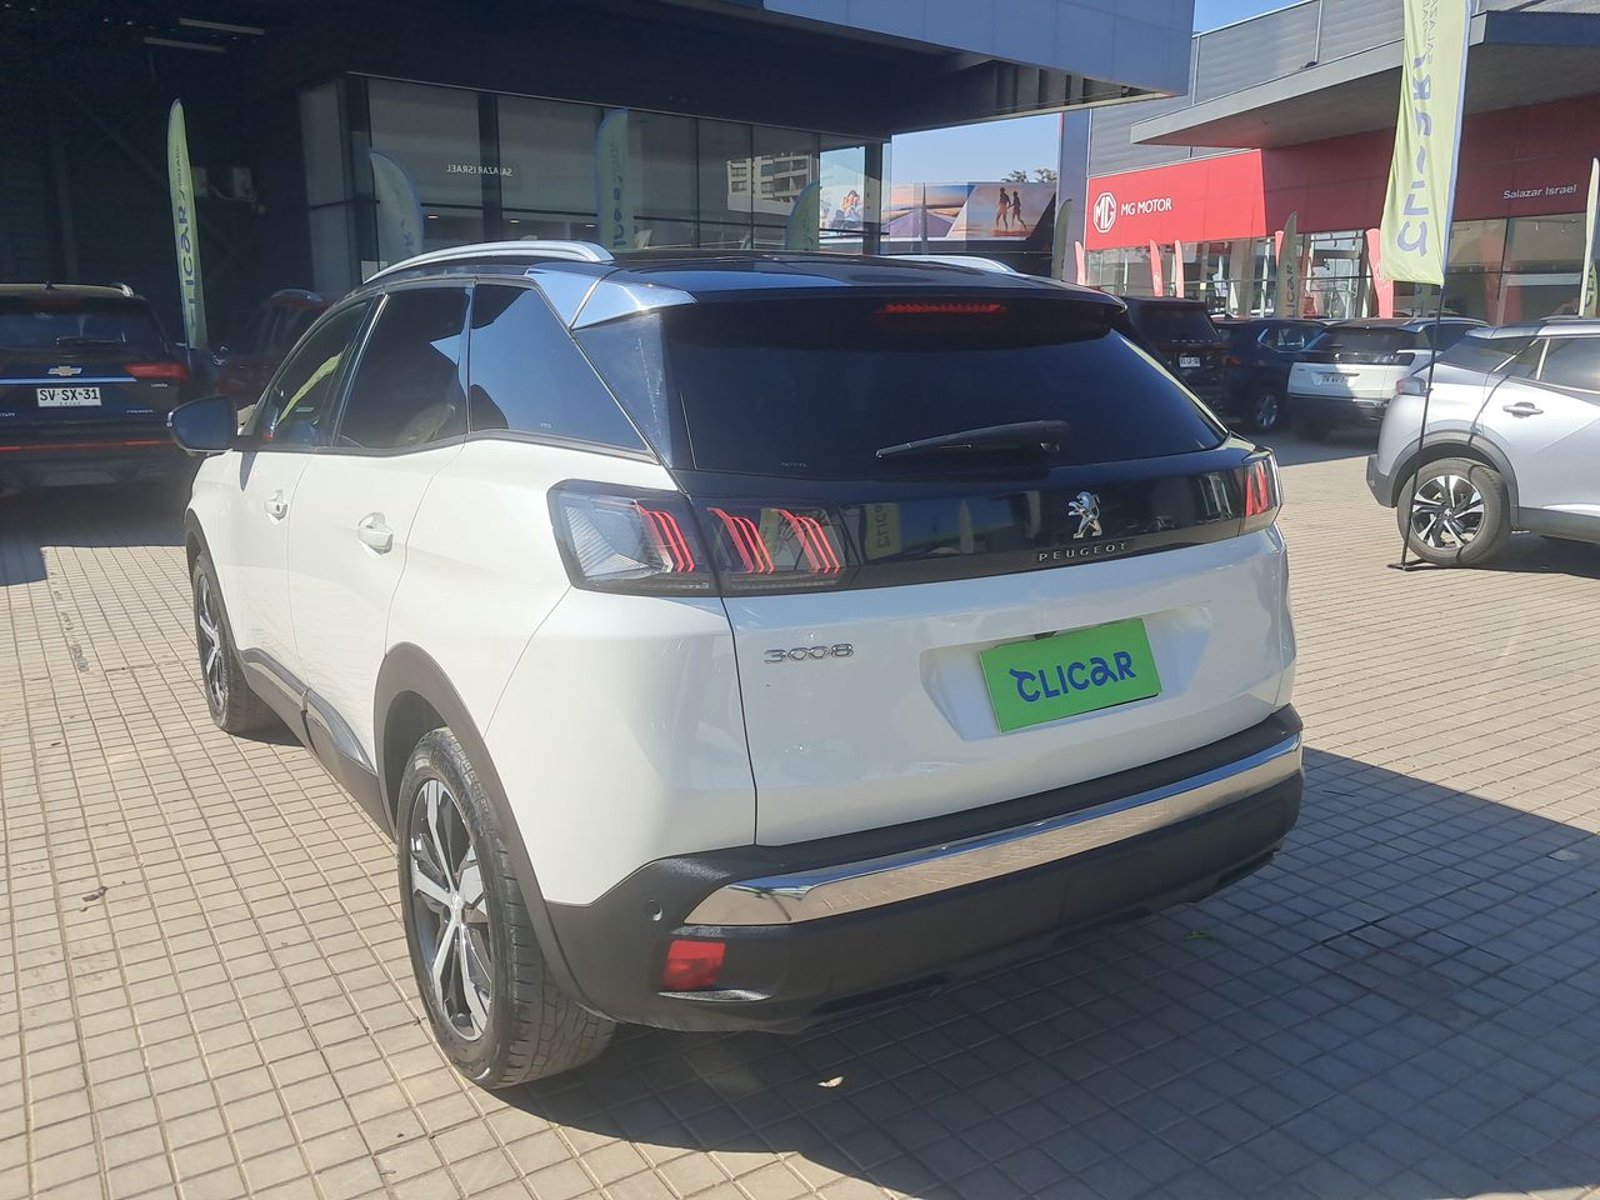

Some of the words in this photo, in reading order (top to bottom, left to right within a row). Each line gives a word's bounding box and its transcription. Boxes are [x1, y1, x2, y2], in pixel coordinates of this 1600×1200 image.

[1503, 188, 1543, 200] Salazar
[1545, 183, 1577, 196] Israel
[1094, 194, 1116, 231] MG
[1121, 203, 1135, 216] MG
[1137, 198, 1172, 214] MOTOR
[1039, 543, 1128, 562] PEUGEOT
[764, 643, 854, 663] 3008
